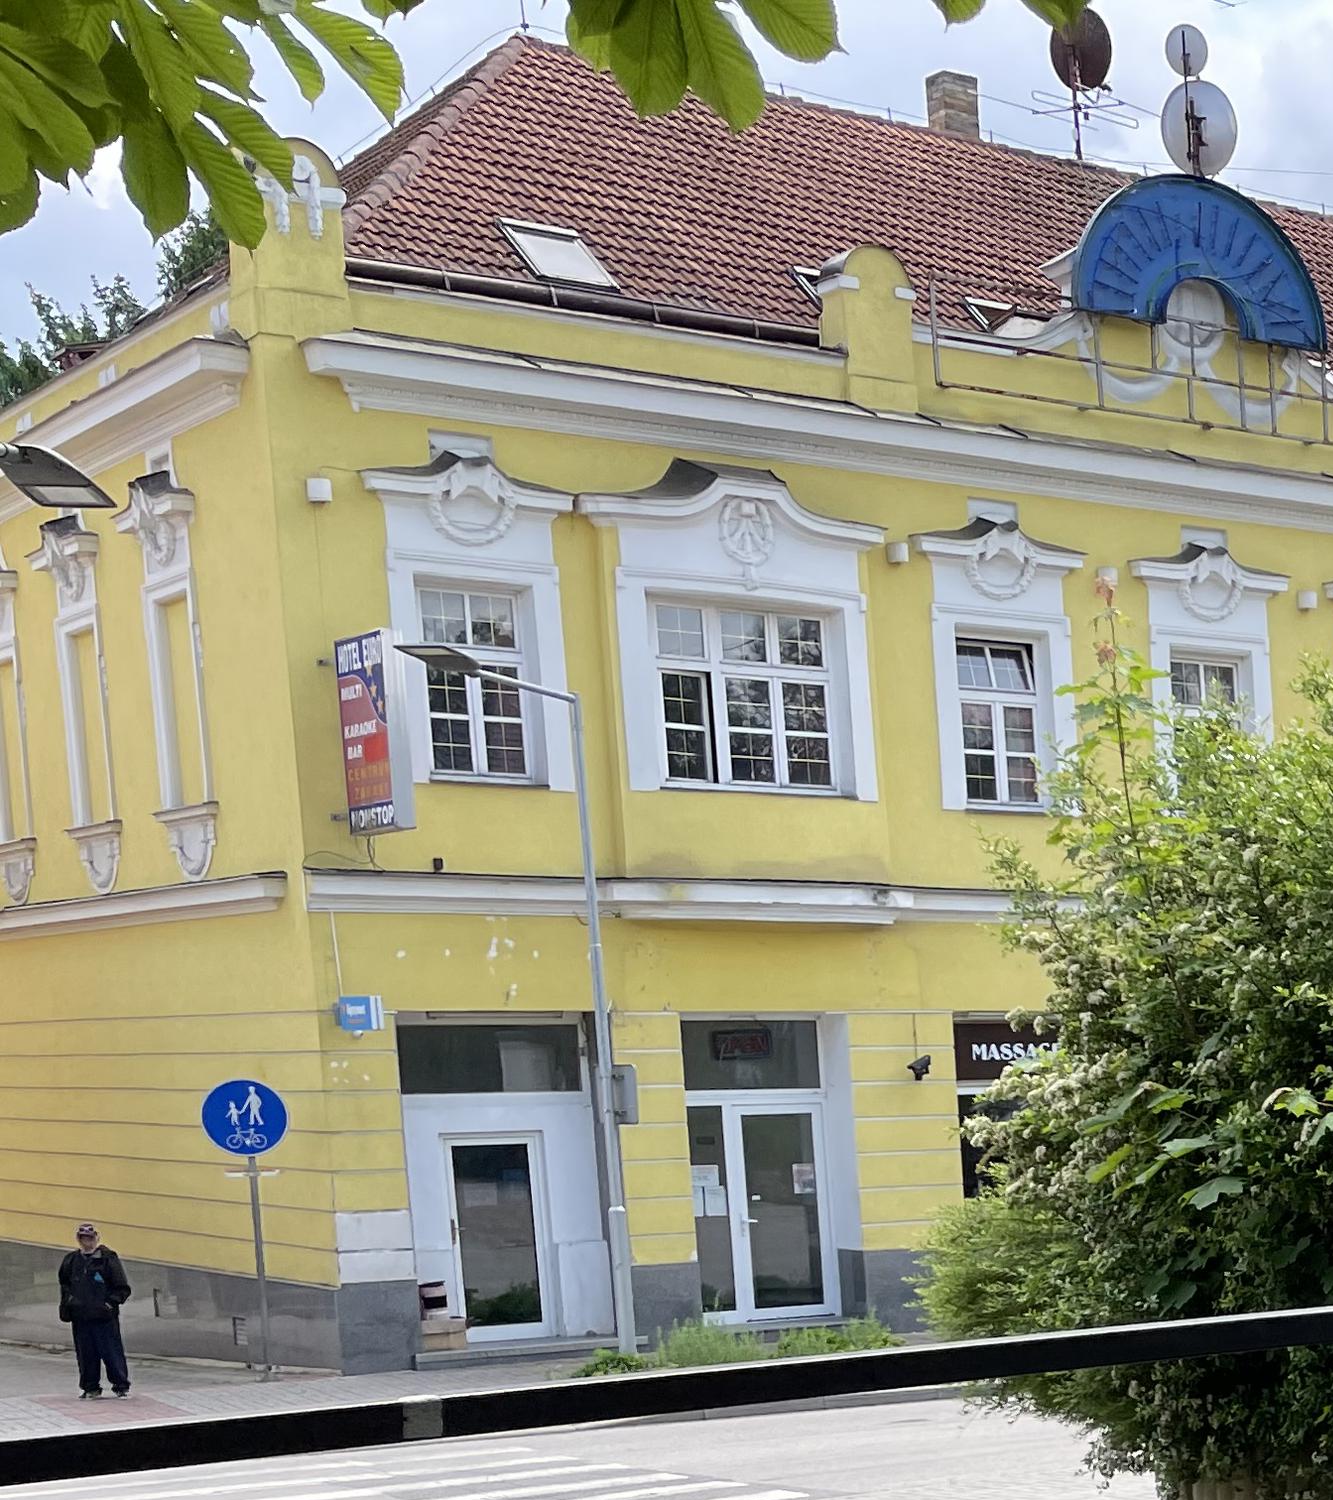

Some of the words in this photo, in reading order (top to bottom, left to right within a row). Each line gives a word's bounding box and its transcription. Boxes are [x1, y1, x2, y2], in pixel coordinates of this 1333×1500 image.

[337, 641, 362, 674] HOTEL
[362, 634, 382, 667] EURO
[344, 719, 377, 739] KARAOKE
[347, 744, 363, 760] BAR
